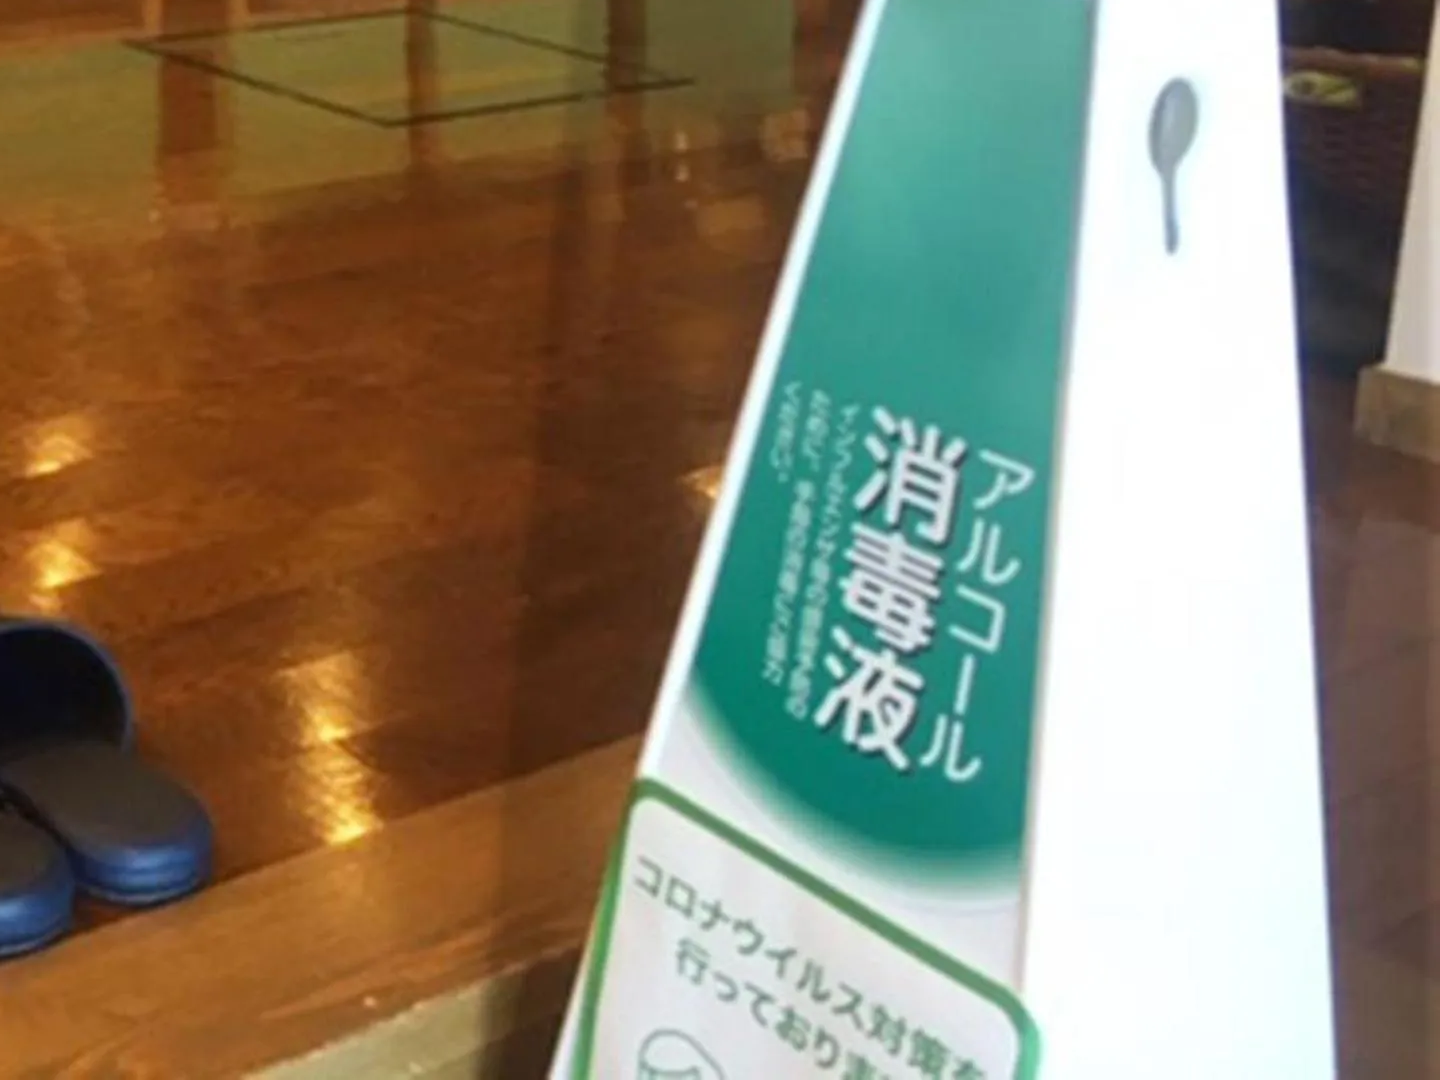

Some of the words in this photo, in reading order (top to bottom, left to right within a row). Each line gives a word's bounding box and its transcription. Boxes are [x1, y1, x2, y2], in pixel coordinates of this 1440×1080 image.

[815, 405, 965, 770] 消毒液
[921, 448, 1035, 781] アルコール
